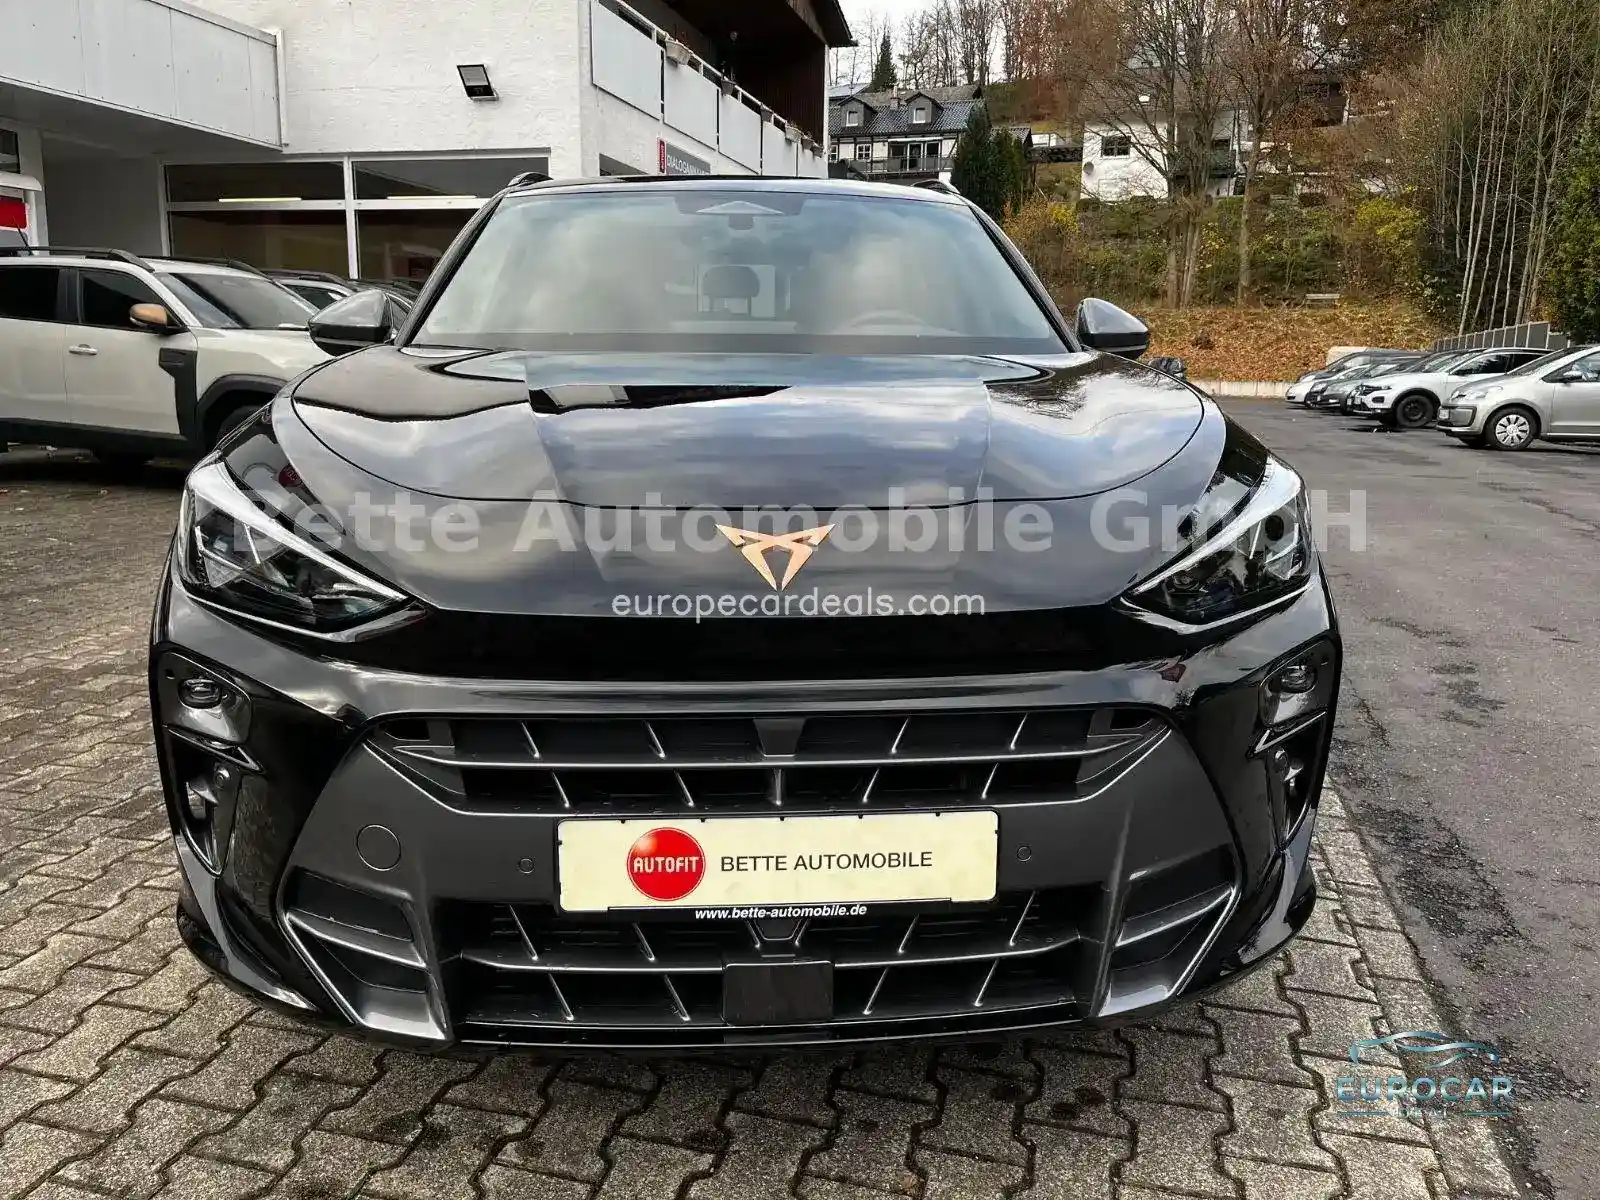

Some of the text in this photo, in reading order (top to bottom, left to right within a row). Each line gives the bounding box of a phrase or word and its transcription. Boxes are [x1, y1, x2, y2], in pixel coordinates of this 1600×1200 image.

[633, 856, 700, 873] AUTOFIT
[720, 851, 933, 872] BETTE AUTOMOBILE
[695, 903, 868, 920] www.bette-automobile.de
